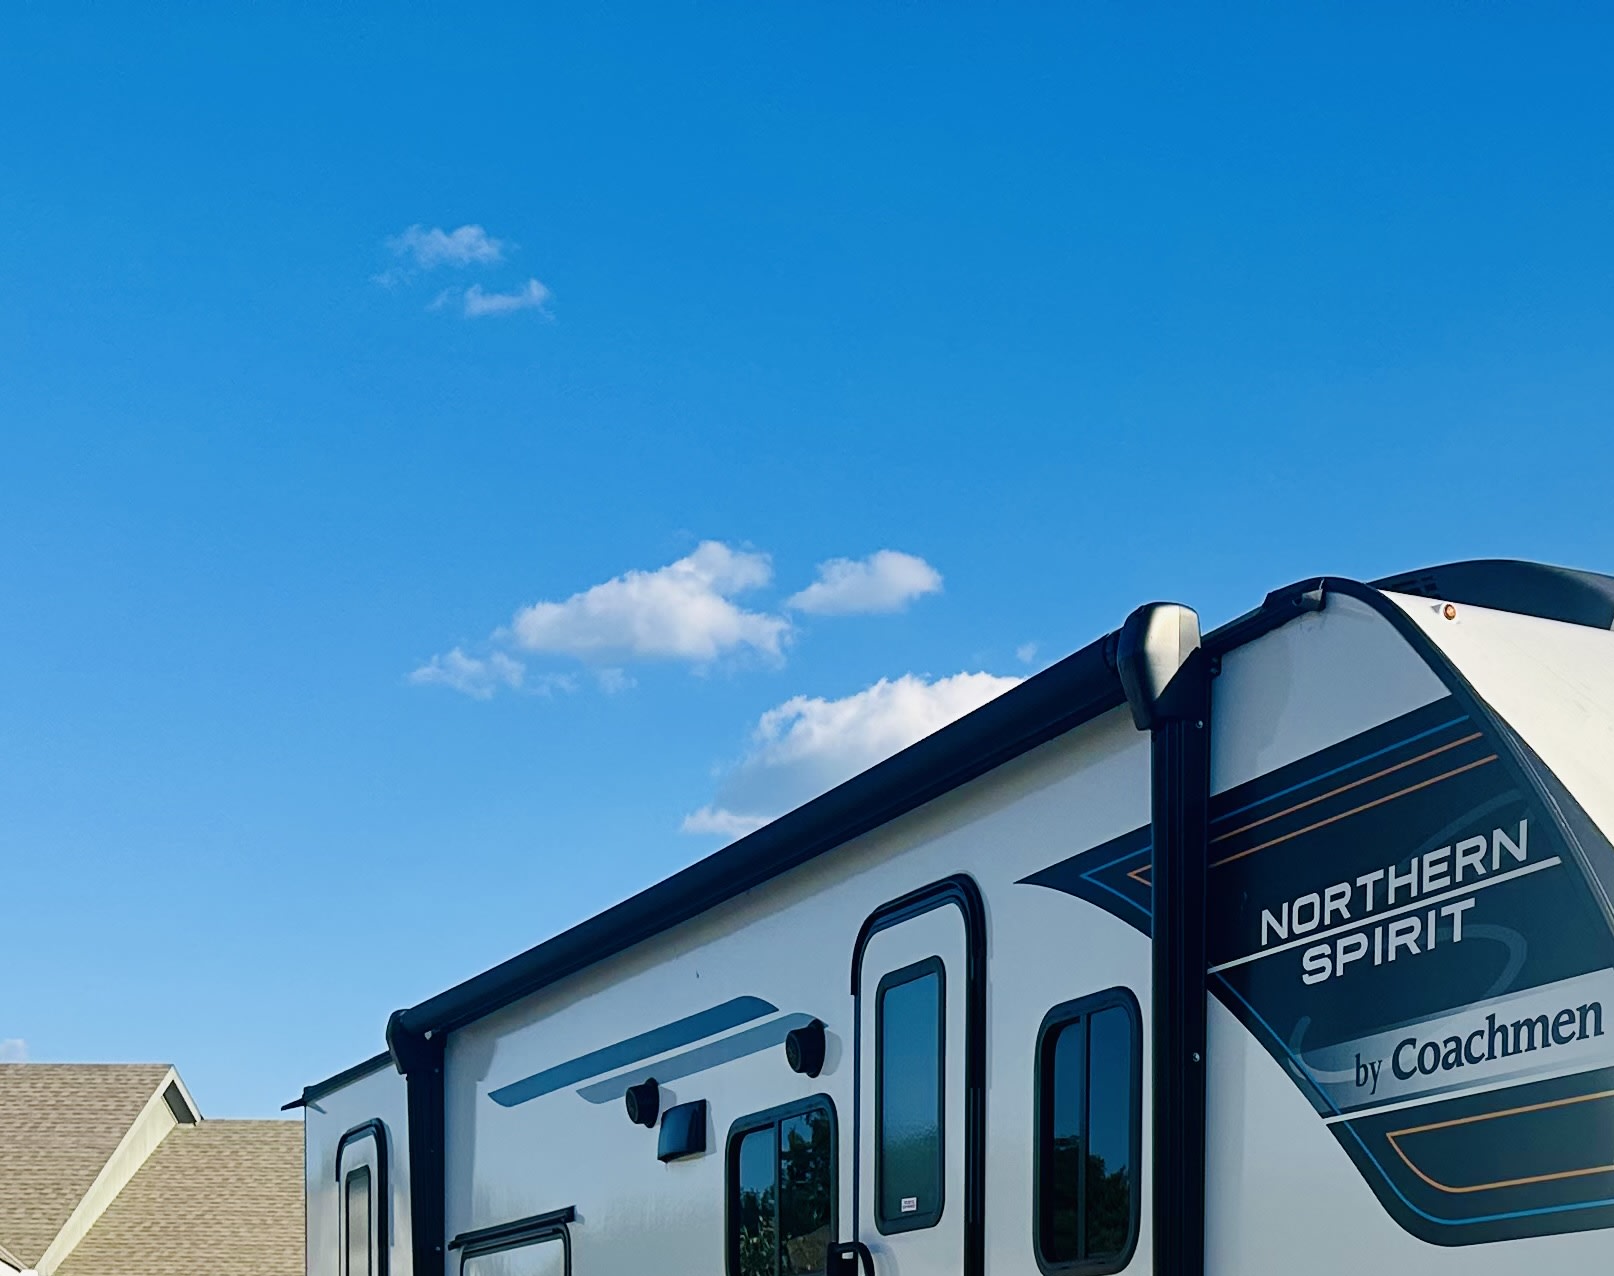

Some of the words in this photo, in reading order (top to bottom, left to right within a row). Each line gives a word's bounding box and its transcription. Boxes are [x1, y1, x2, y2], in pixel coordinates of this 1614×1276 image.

[1261, 818, 1528, 946] NORTHERN
[1302, 897, 1476, 986] SPIRIT
[1355, 1052, 1383, 1095] by
[1391, 1001, 1604, 1082] Coachmen
